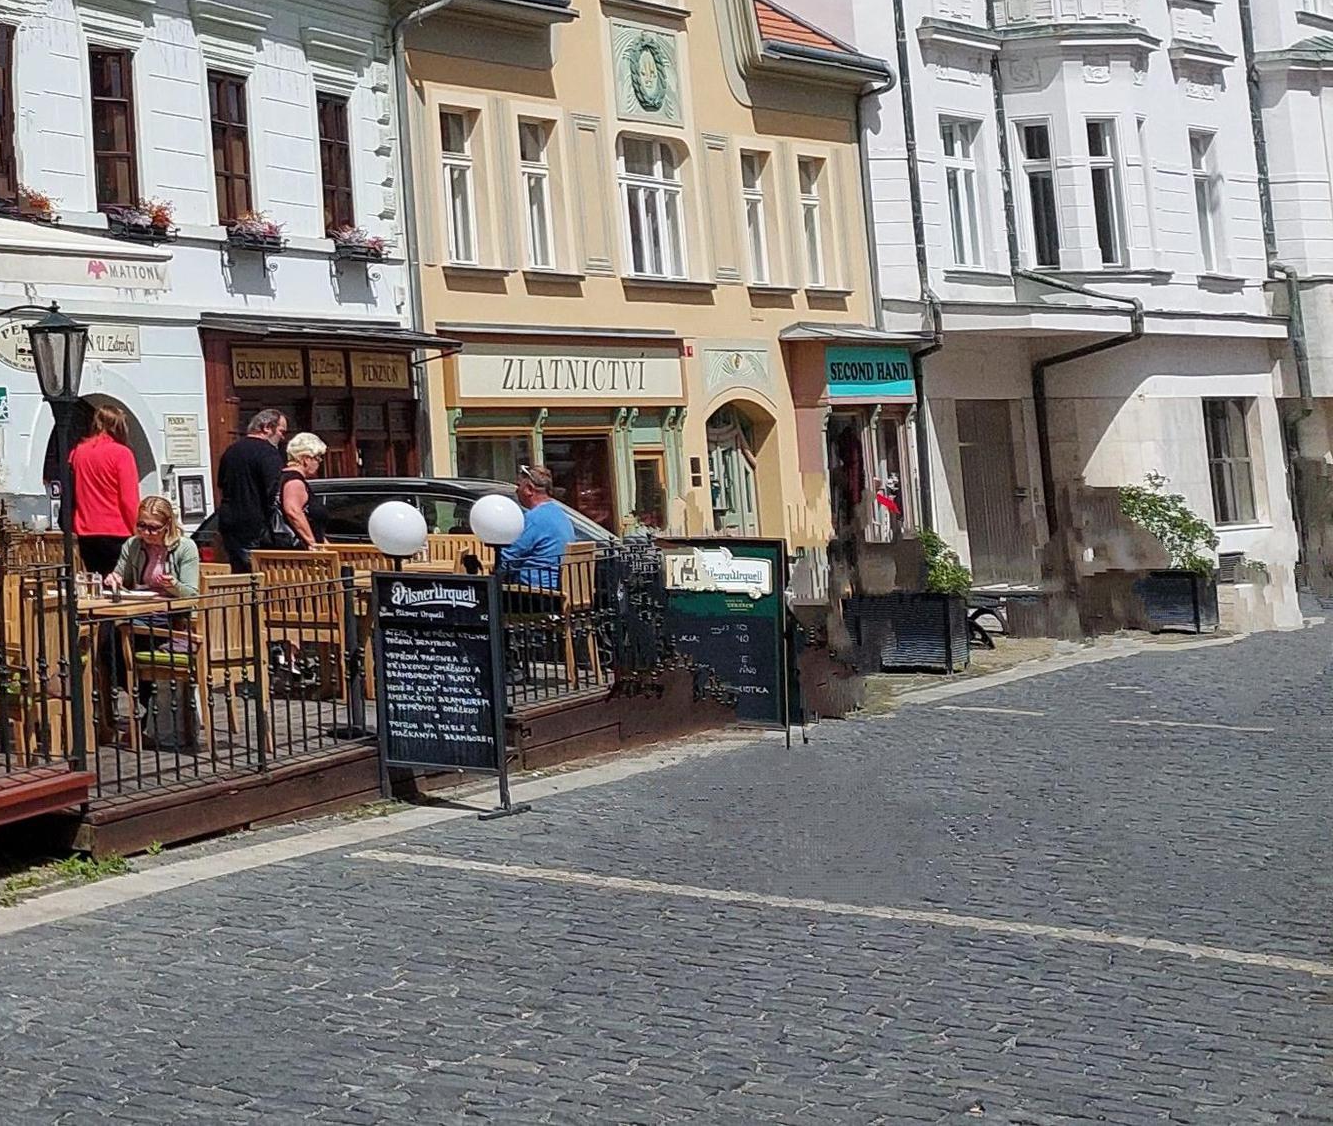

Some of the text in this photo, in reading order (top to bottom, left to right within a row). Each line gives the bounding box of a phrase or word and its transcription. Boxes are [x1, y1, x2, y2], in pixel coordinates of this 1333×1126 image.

[109, 265, 160, 280] MATTONI
[236, 361, 300, 380] GUEST HOUSE
[502, 351, 646, 391] ZLATNICTVÍ
[830, 360, 909, 382] SECOND HAND
